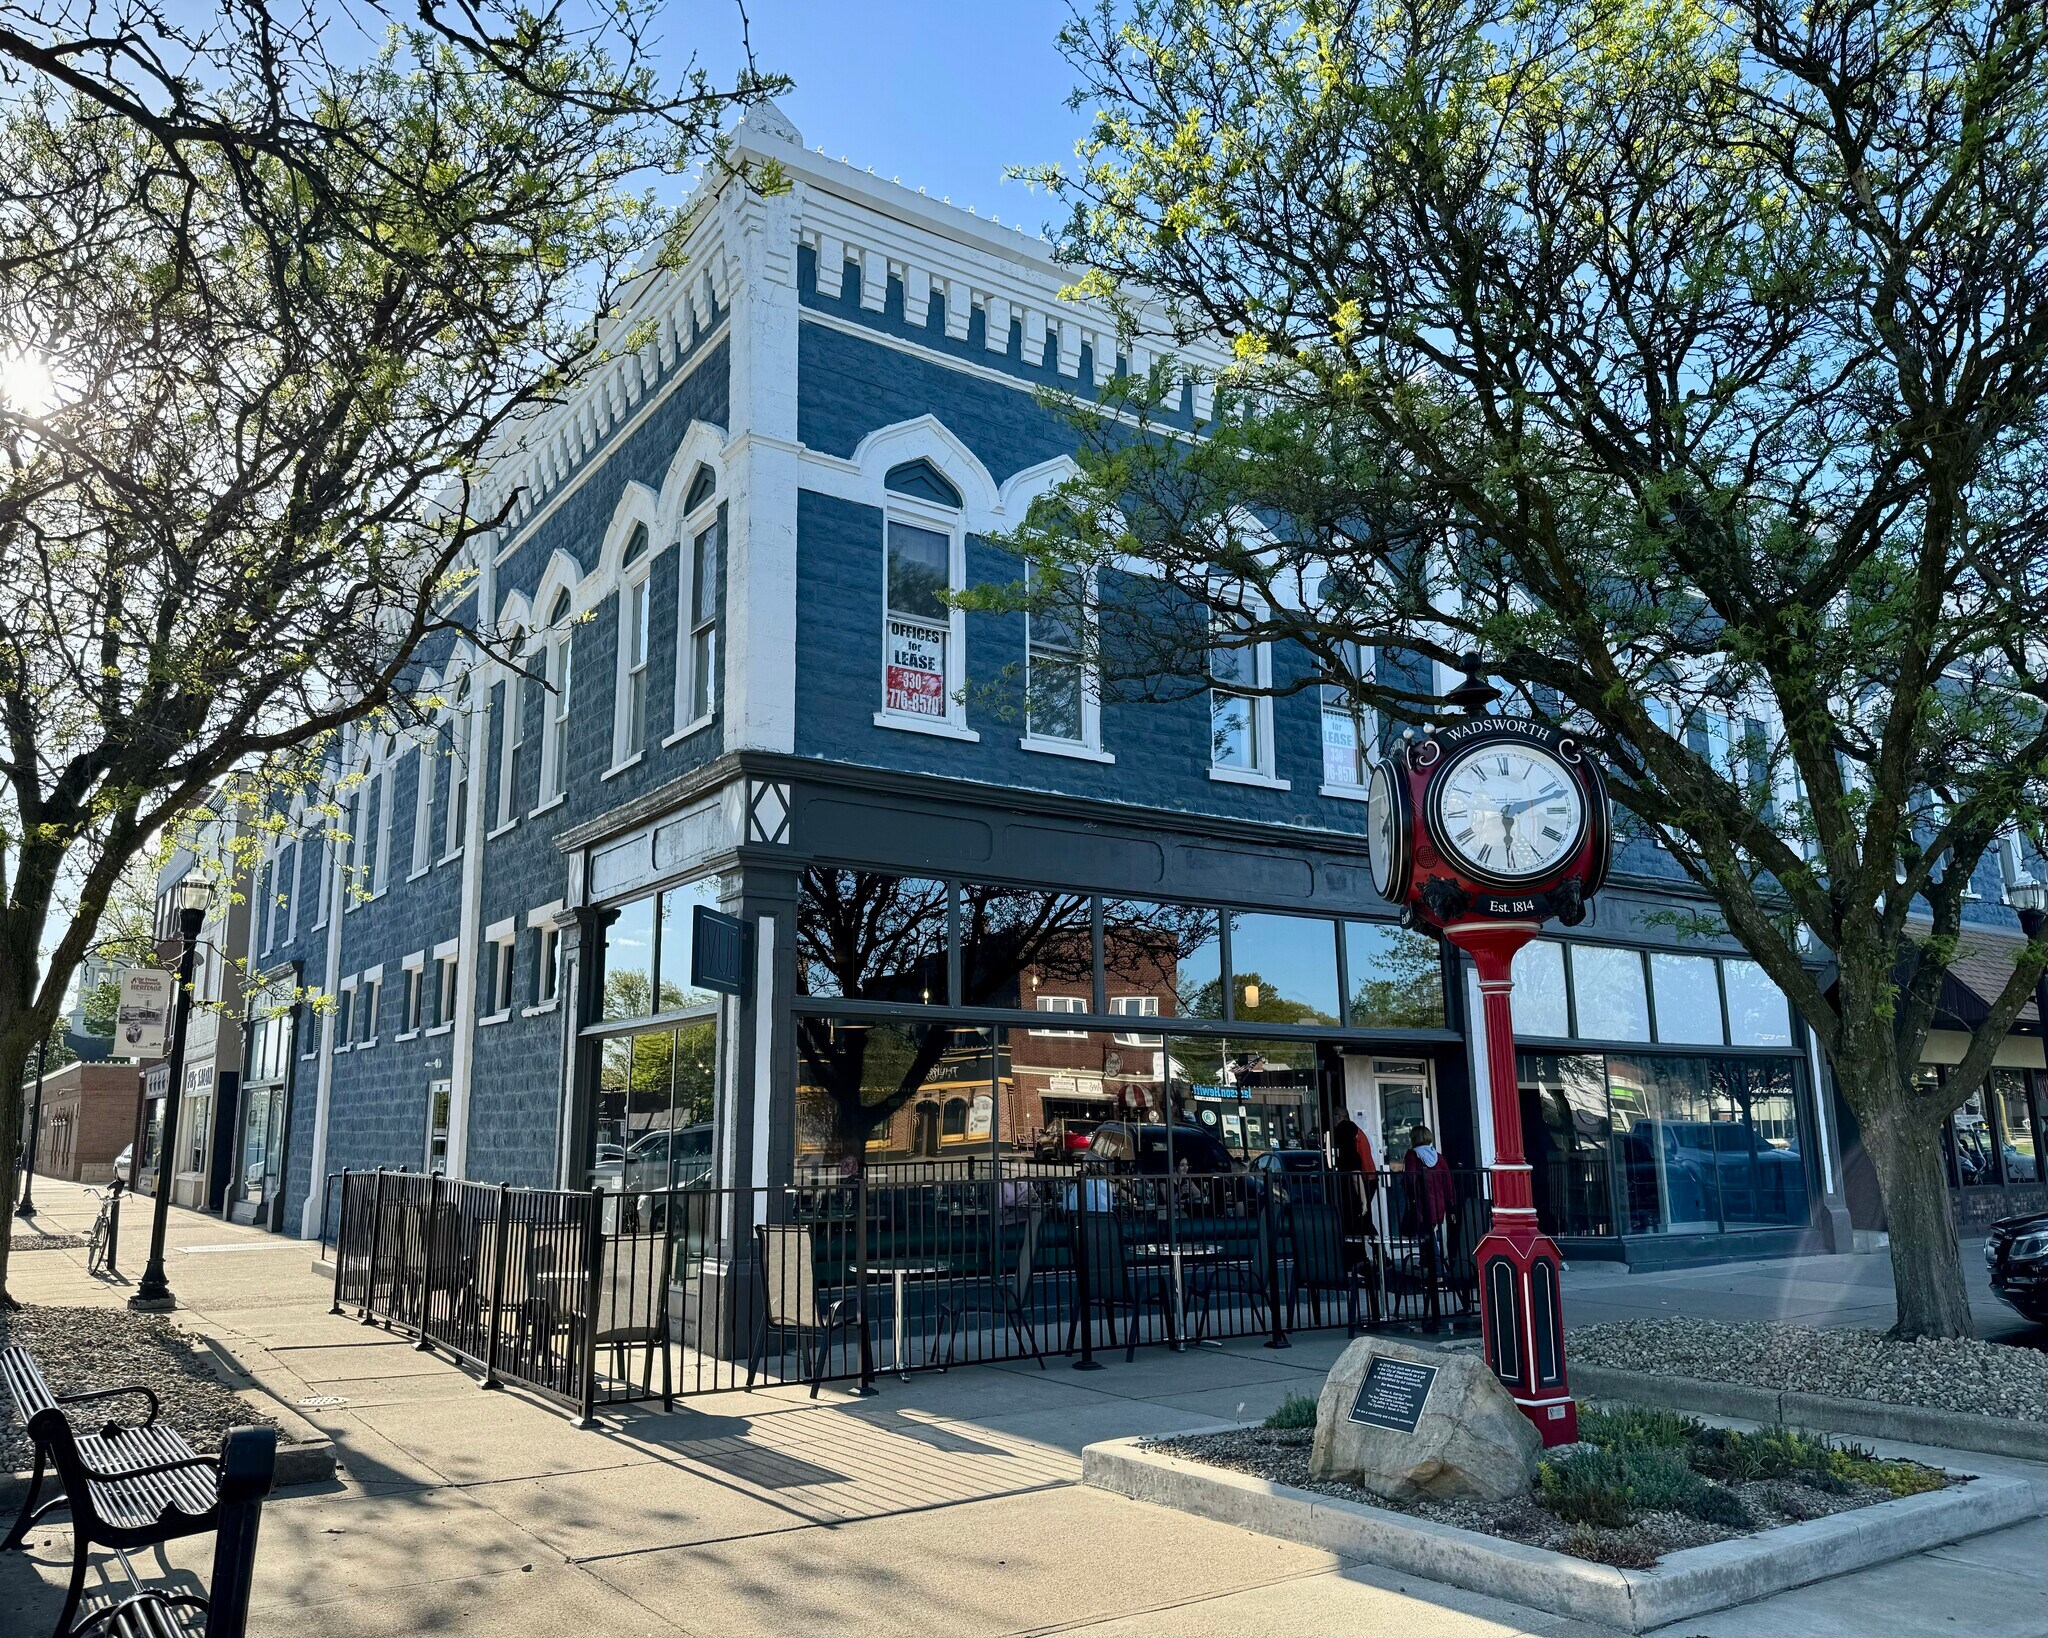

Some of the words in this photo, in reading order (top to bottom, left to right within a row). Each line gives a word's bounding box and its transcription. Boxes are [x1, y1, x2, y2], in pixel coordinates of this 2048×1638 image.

[892, 622, 939, 643] OFFICES
[908, 641, 922, 652] for
[894, 650, 935, 670] LEASE
[890, 688, 939, 715] 776-8570
[1332, 722, 1342, 731] for
[1447, 719, 1551, 742] WADSWORTH
[1323, 731, 1353, 746] LEASE
[1325, 763, 1358, 783] 76-8570
[1490, 900, 1510, 912] Est.
[1512, 900, 1534, 912] 1814
[706, 922, 737, 979] VUE
[130, 984, 162, 992] HERITAGE
